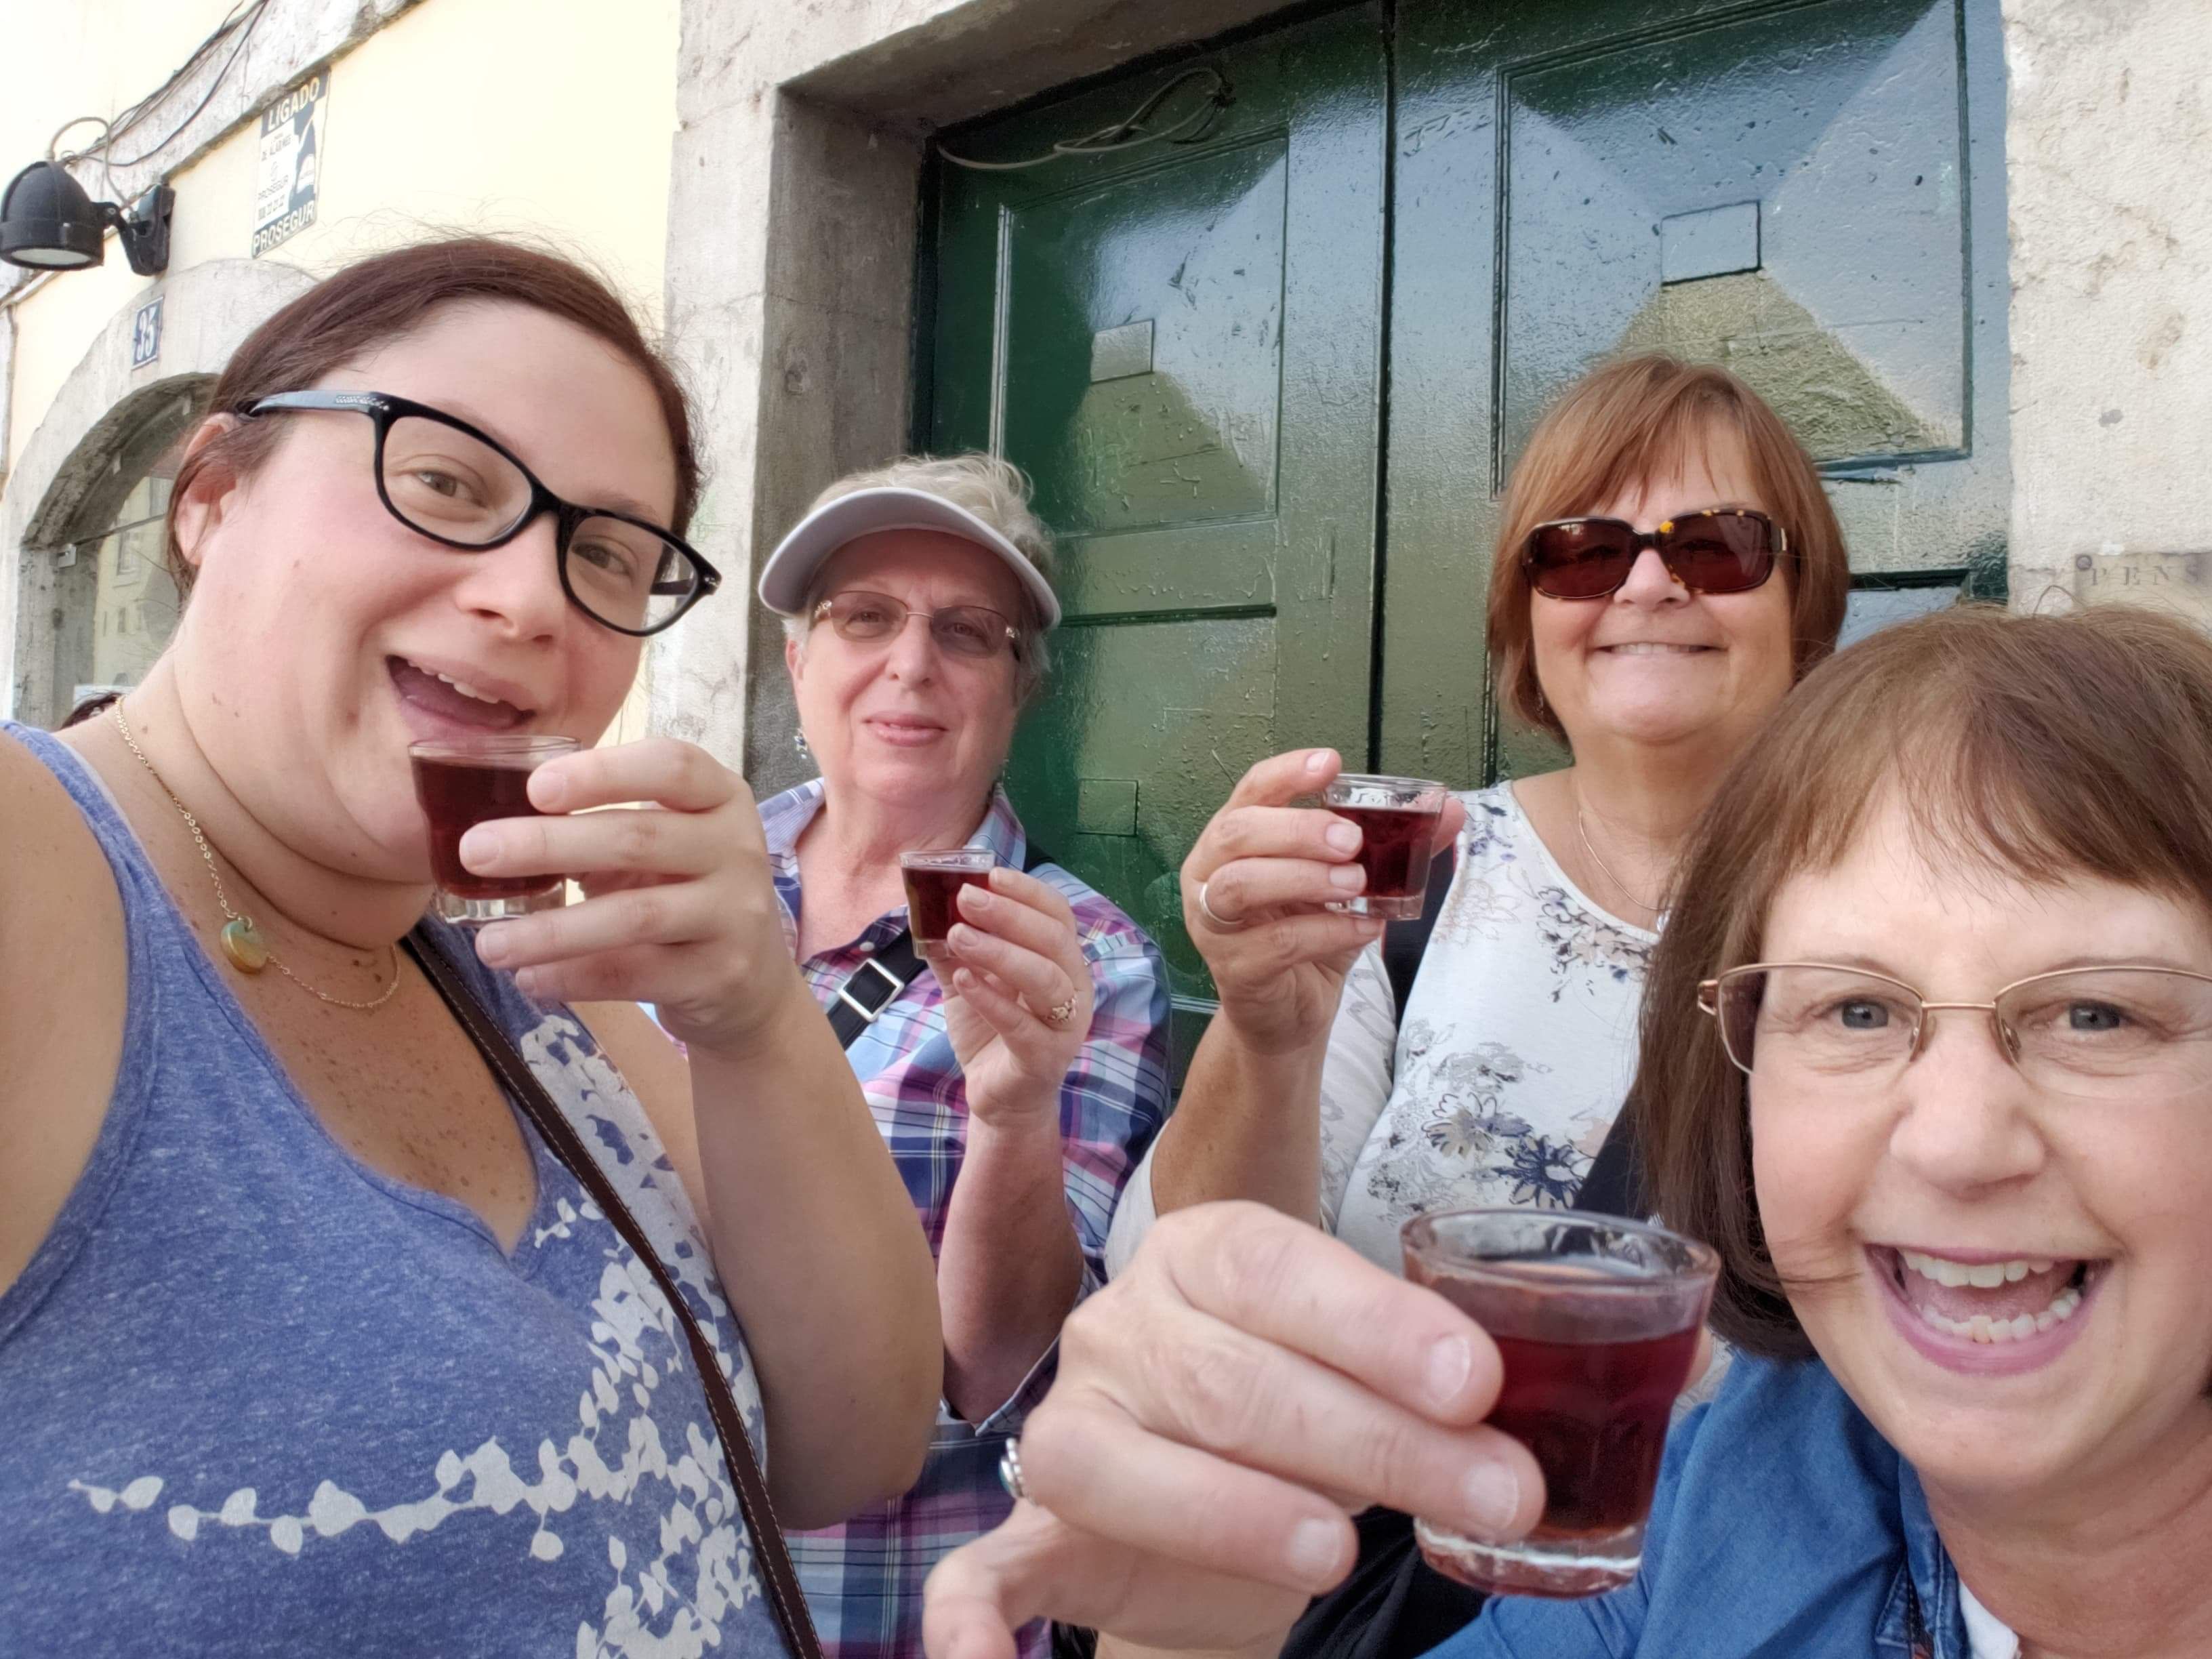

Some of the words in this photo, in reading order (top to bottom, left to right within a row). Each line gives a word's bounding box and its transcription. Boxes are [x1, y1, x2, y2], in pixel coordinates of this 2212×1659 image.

[267, 77, 321, 131] LIGADO
[253, 201, 315, 255] PROSEGUR
[136, 306, 157, 361] 35
